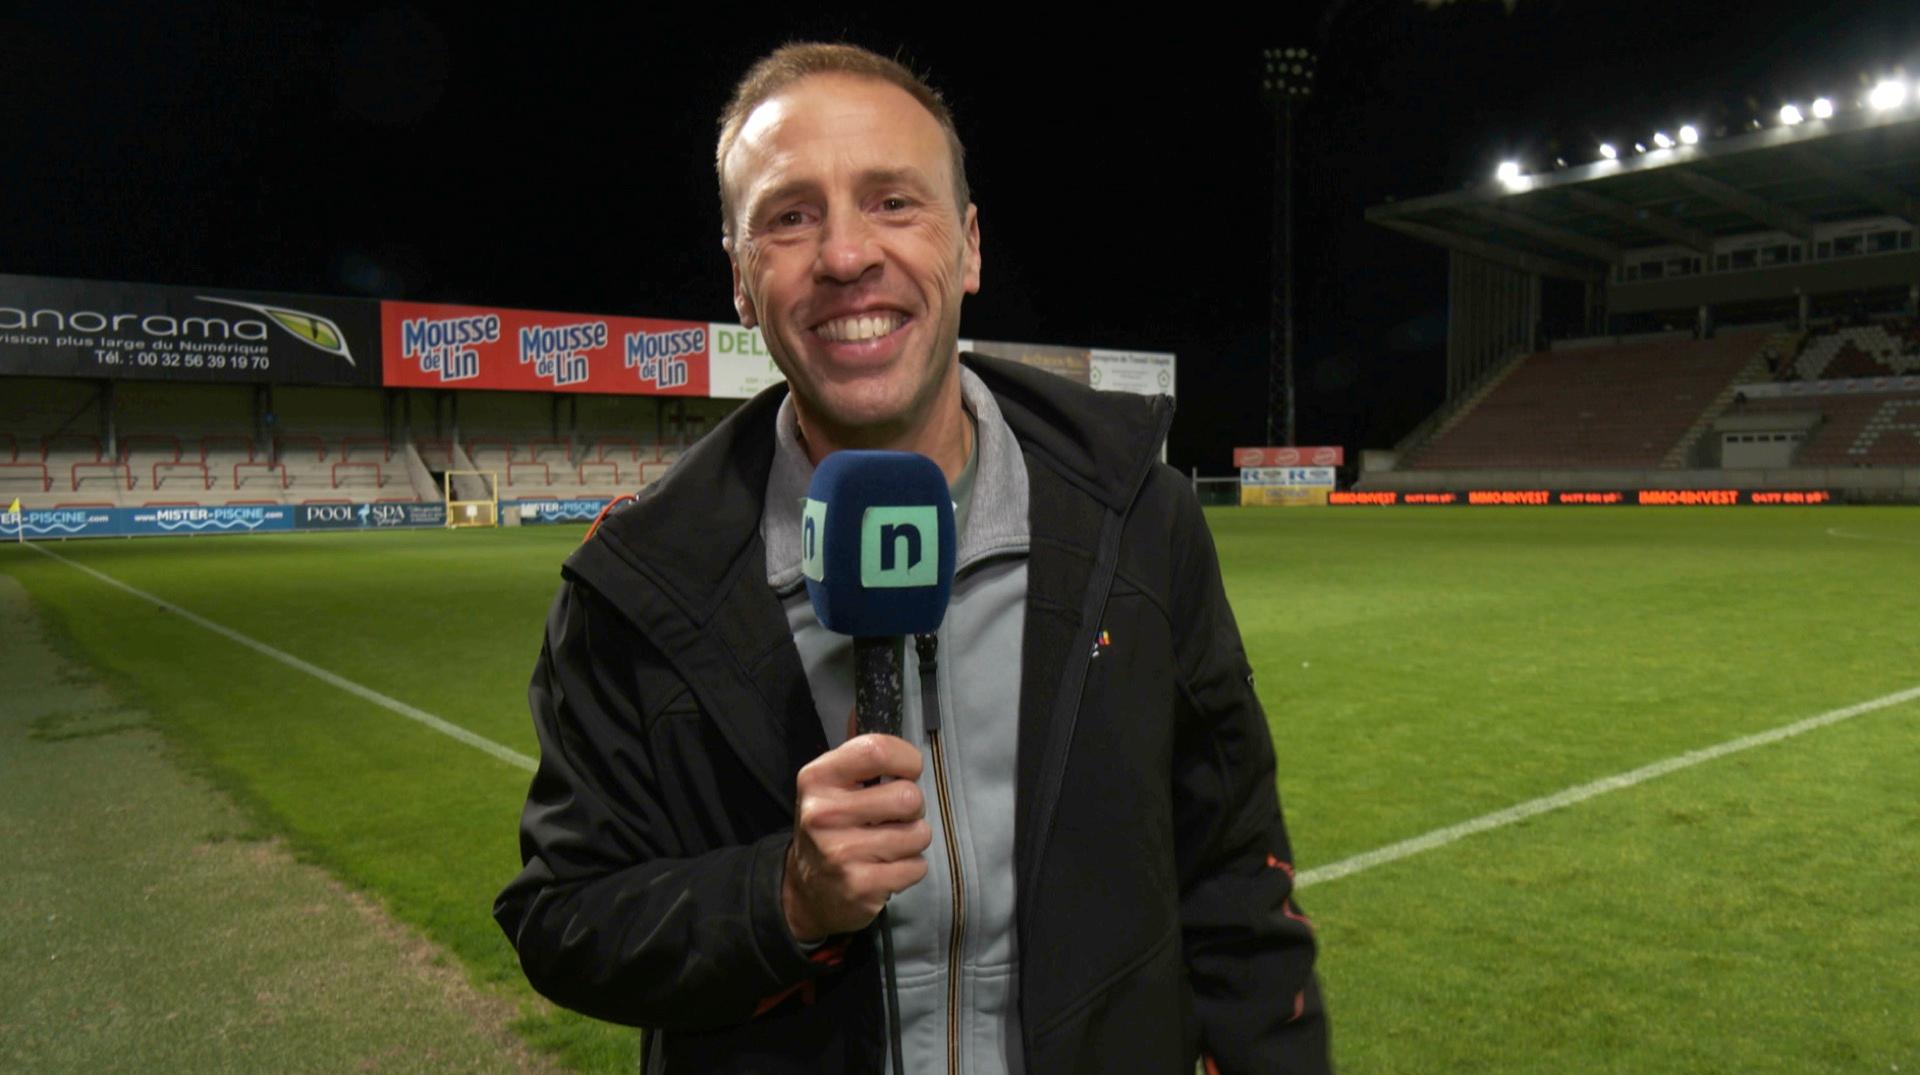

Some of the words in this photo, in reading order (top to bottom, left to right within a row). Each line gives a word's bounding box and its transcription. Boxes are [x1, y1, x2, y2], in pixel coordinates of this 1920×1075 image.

[0, 307, 267, 340] anorama
[404, 315, 499, 356] Mousse
[56, 336, 94, 347] plus
[101, 337, 147, 351] large
[152, 340, 173, 351] du
[180, 341, 269, 356] Numérique
[520, 321, 607, 363] Mousse
[625, 328, 705, 368] Mousse
[718, 330, 768, 356] DEL
[94, 349, 123, 364] Tél.
[137, 352, 158, 366] 00
[161, 353, 180, 367] 32
[184, 354, 204, 368] 56
[207, 355, 226, 369] 39
[230, 356, 248, 370] 19
[251, 357, 270, 370] 70
[420, 352, 440, 372] de
[441, 346, 478, 380] Lin
[536, 359, 554, 377] de
[554, 355, 588, 385] Lin
[640, 363, 656, 381] de
[656, 358, 687, 389] Lin
[307, 505, 354, 521] POOL
[372, 504, 405, 519] SPA
[1468, 491, 1550, 504] IMMO4INVEST
[1639, 490, 1738, 504] IMMO4INVEST
[804, 516, 815, 561] n
[880, 523, 922, 571] n
